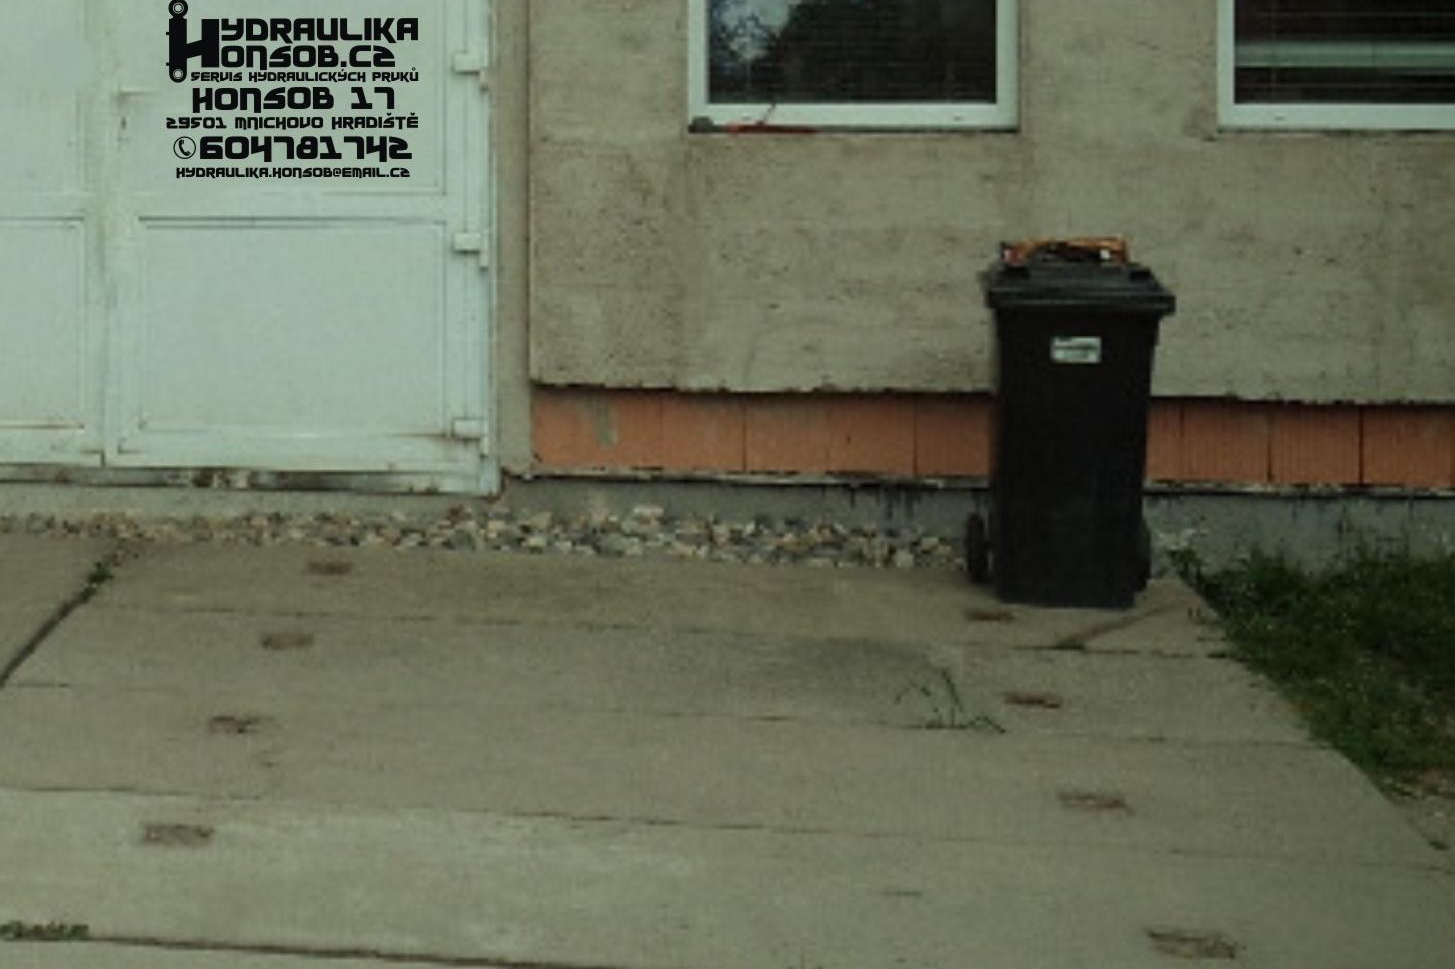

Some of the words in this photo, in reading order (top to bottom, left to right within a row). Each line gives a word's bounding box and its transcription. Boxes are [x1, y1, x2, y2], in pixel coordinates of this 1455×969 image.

[190, 71, 243, 83] SERVIS
[248, 69, 366, 83] HYDRAULICKÝCH
[372, 66, 419, 83] PRVKŮ
[192, 86, 335, 114] HONSOB
[350, 86, 395, 111] 17
[166, 116, 227, 130] 29501
[234, 116, 324, 131] MNICHOVO
[331, 112, 419, 131] HRADIŠTĚ
[199, 135, 413, 163] 604781742
